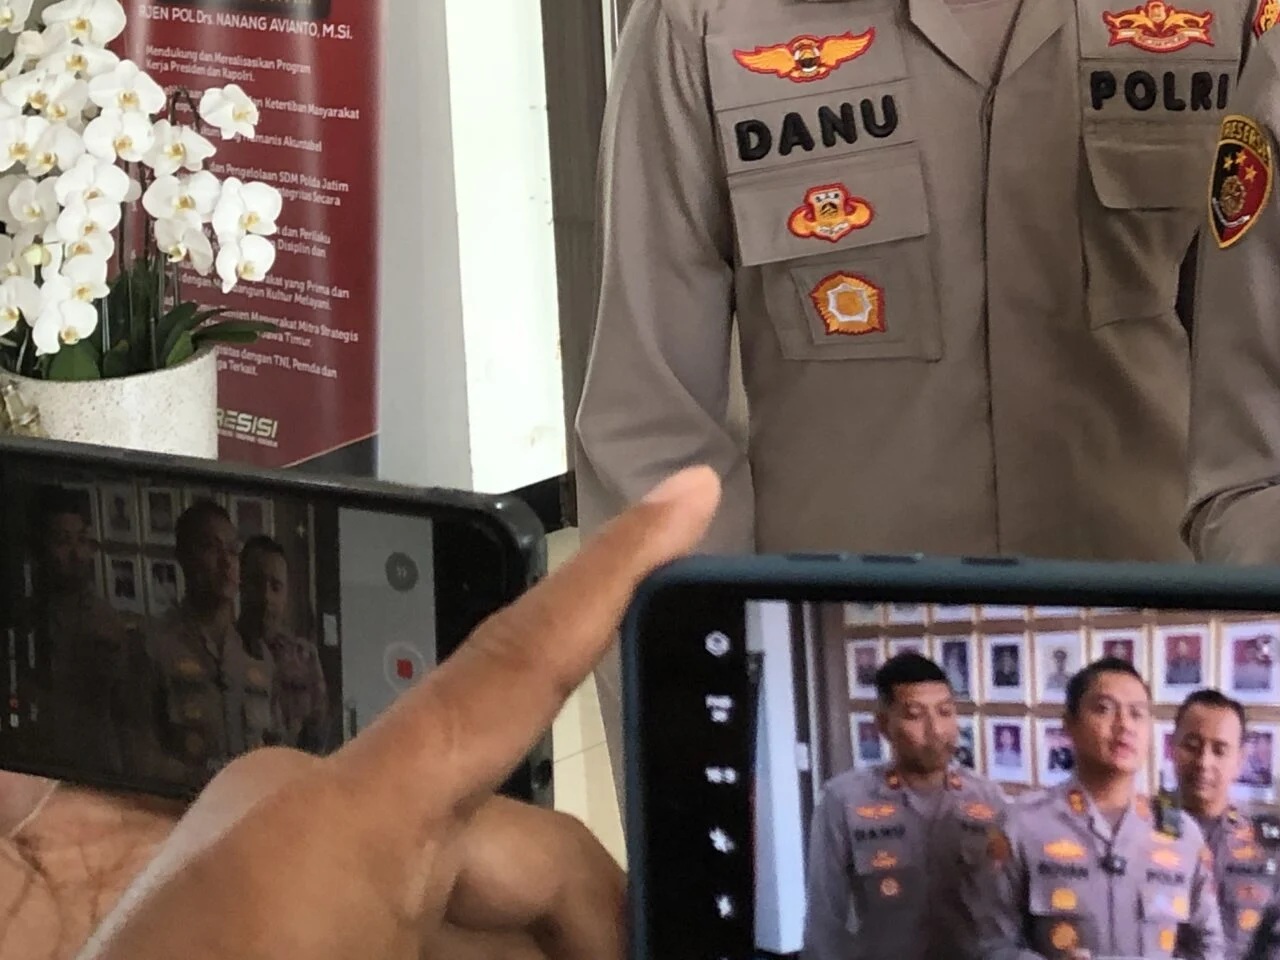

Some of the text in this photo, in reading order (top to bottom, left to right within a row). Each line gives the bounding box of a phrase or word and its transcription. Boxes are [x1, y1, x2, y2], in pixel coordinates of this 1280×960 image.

[216, 14, 268, 30] NANANG
[269, 18, 321, 38] AVIANTO,
[146, 45, 311, 75] Mendukung dan Merealisasikan Program
[146, 60, 168, 72] Kerja
[170, 61, 207, 76] Presiden
[207, 66, 221, 77] dan
[1090, 69, 1230, 112] POLRI
[264, 97, 307, 116] Ketertiban
[307, 102, 360, 120] Masyarakat
[735, 95, 899, 162] DANU
[209, 162, 350, 192] dan Pengelolaan SDM Polda Jatim
[312, 191, 341, 207] Secara
[281, 227, 332, 244] dan Perilaku
[278, 240, 327, 258] Disiplin dan
[266, 287, 293, 303] Kultur
[284, 278, 304, 293] yang
[306, 279, 330, 296] Prima
[331, 286, 350, 299] dan
[297, 319, 320, 334] Mitra
[320, 325, 359, 343] Strategis
[241, 348, 273, 366] dengan
[321, 365, 338, 380] dan
[216, 408, 279, 439] RESISI
